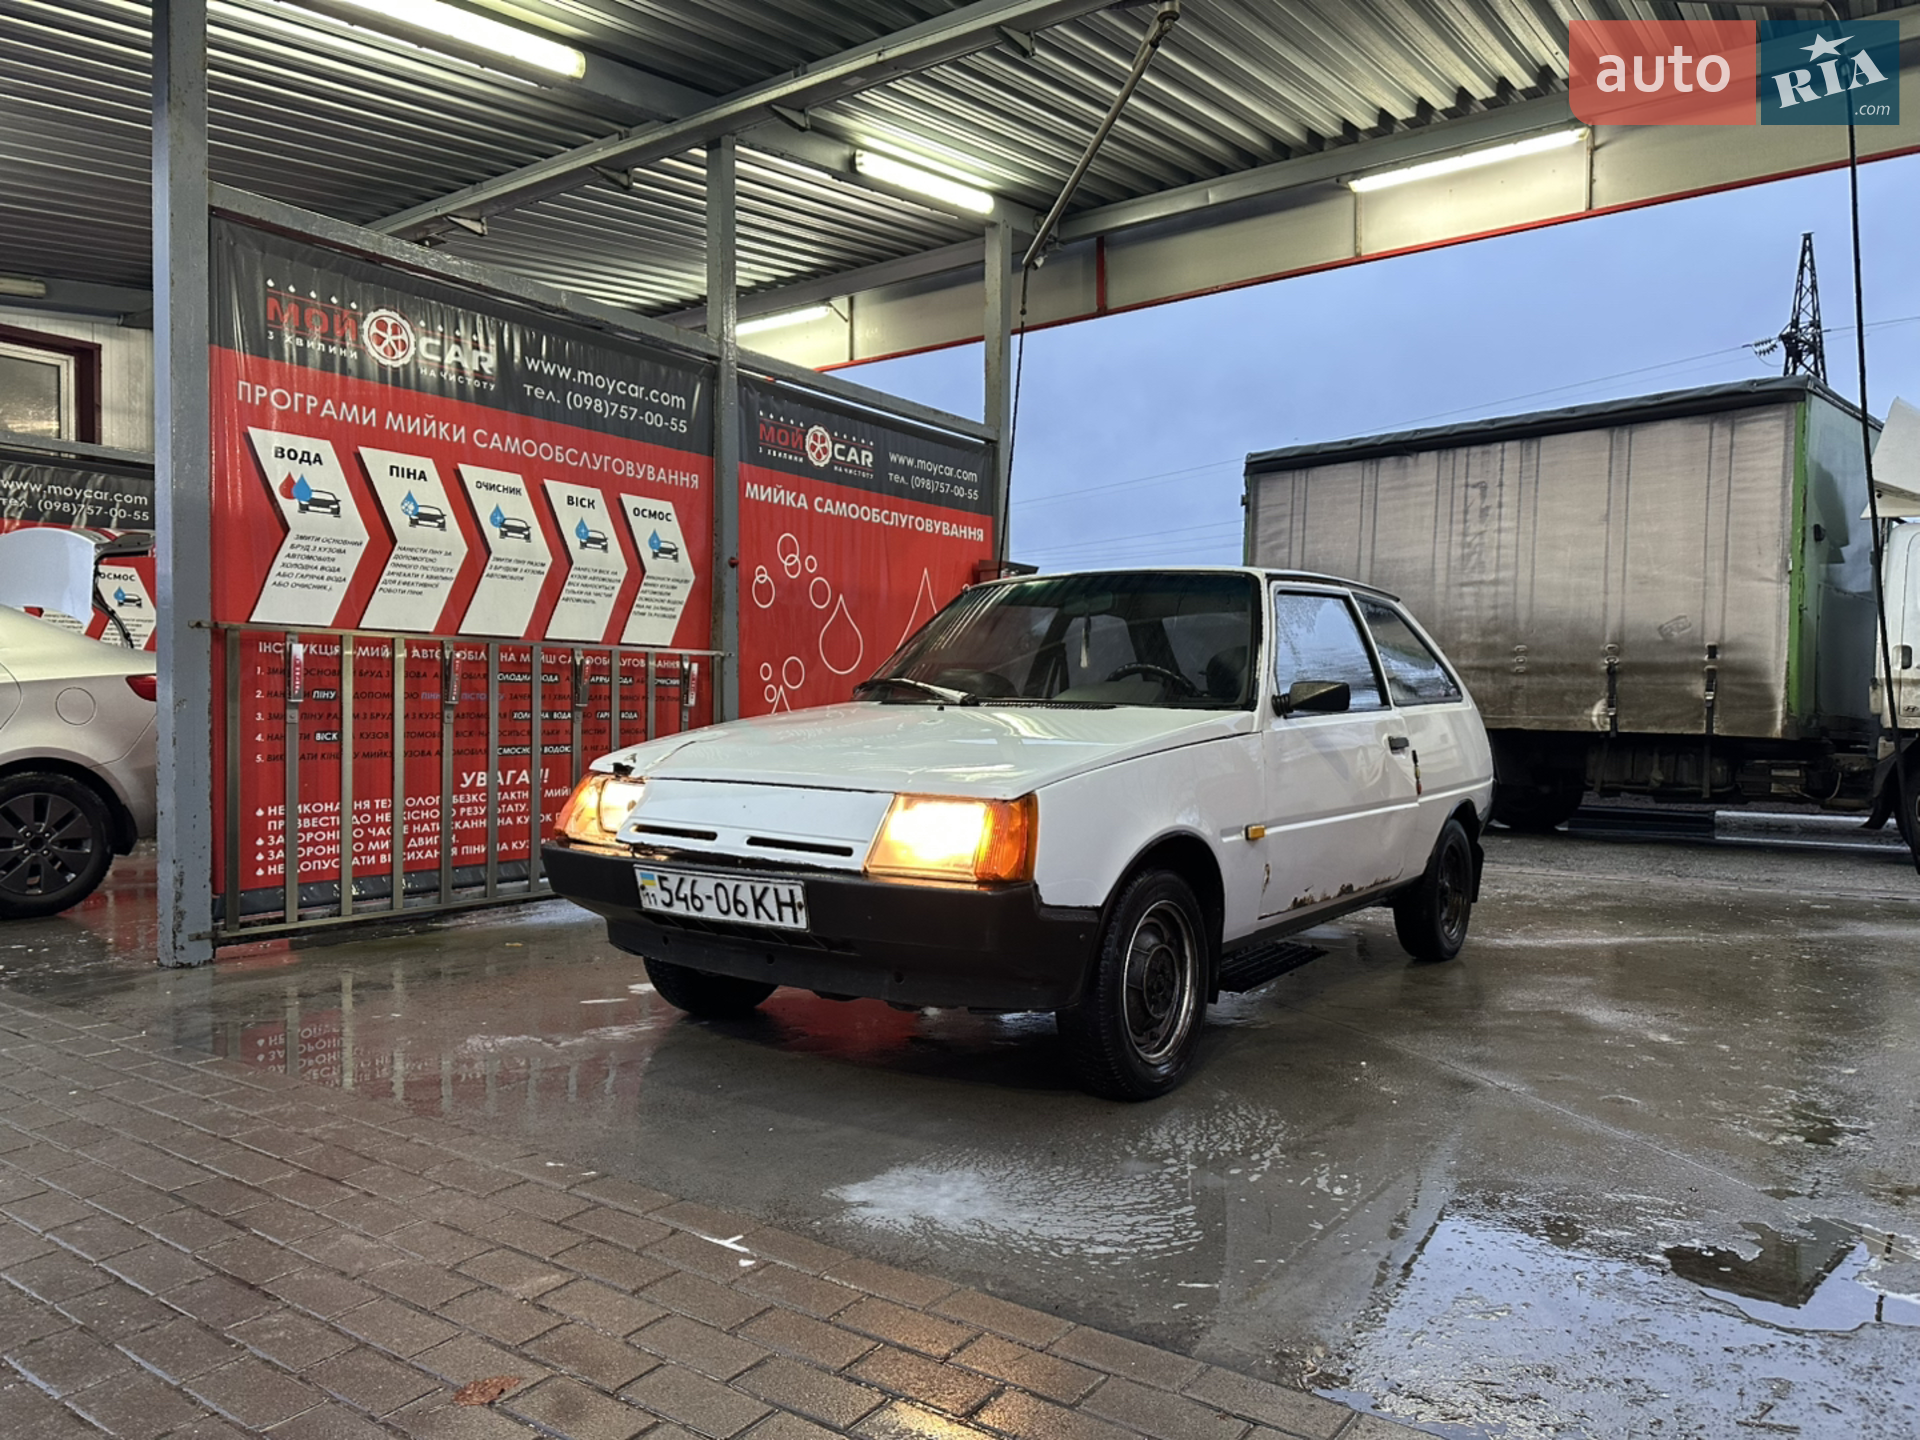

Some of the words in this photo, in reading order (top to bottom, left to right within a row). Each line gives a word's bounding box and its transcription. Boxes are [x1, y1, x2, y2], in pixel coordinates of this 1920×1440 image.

[267, 296, 358, 342] МОЙ
[419, 336, 494, 375] CAR
[284, 334, 358, 360] ХВИЛИНИ
[419, 366, 437, 378] НА
[440, 371, 496, 392] ЧИСТОТУ
[525, 356, 686, 411] www.moycar.com
[566, 390, 688, 434] (098)757-00-55
[237, 380, 377, 428] ПРОГРАМИ
[385, 411, 467, 445] МИЙКИ
[473, 428, 700, 489] САМООБСЛУГОВУВАННЯ
[760, 423, 804, 450] МОЙ
[833, 443, 874, 468] CAR
[274, 446, 324, 467] ВОДА
[389, 465, 428, 483] ПІНА
[888, 452, 978, 493] www.moycar.com
[0, 480, 149, 506] www.moycar.com
[475, 480, 523, 496] ОЧИСНИК
[911, 475, 980, 501] (098)757-00-55
[38, 499, 150, 521] (098)757-00-55
[566, 495, 596, 510] ВІСК
[632, 507, 673, 522] ОСМОС
[745, 482, 809, 510] МИЙКА
[813, 496, 985, 542] САМООБСЛУГОВУВАННЯ
[312, 689, 337, 700] ПІНУ
[314, 732, 339, 741] ВІСК
